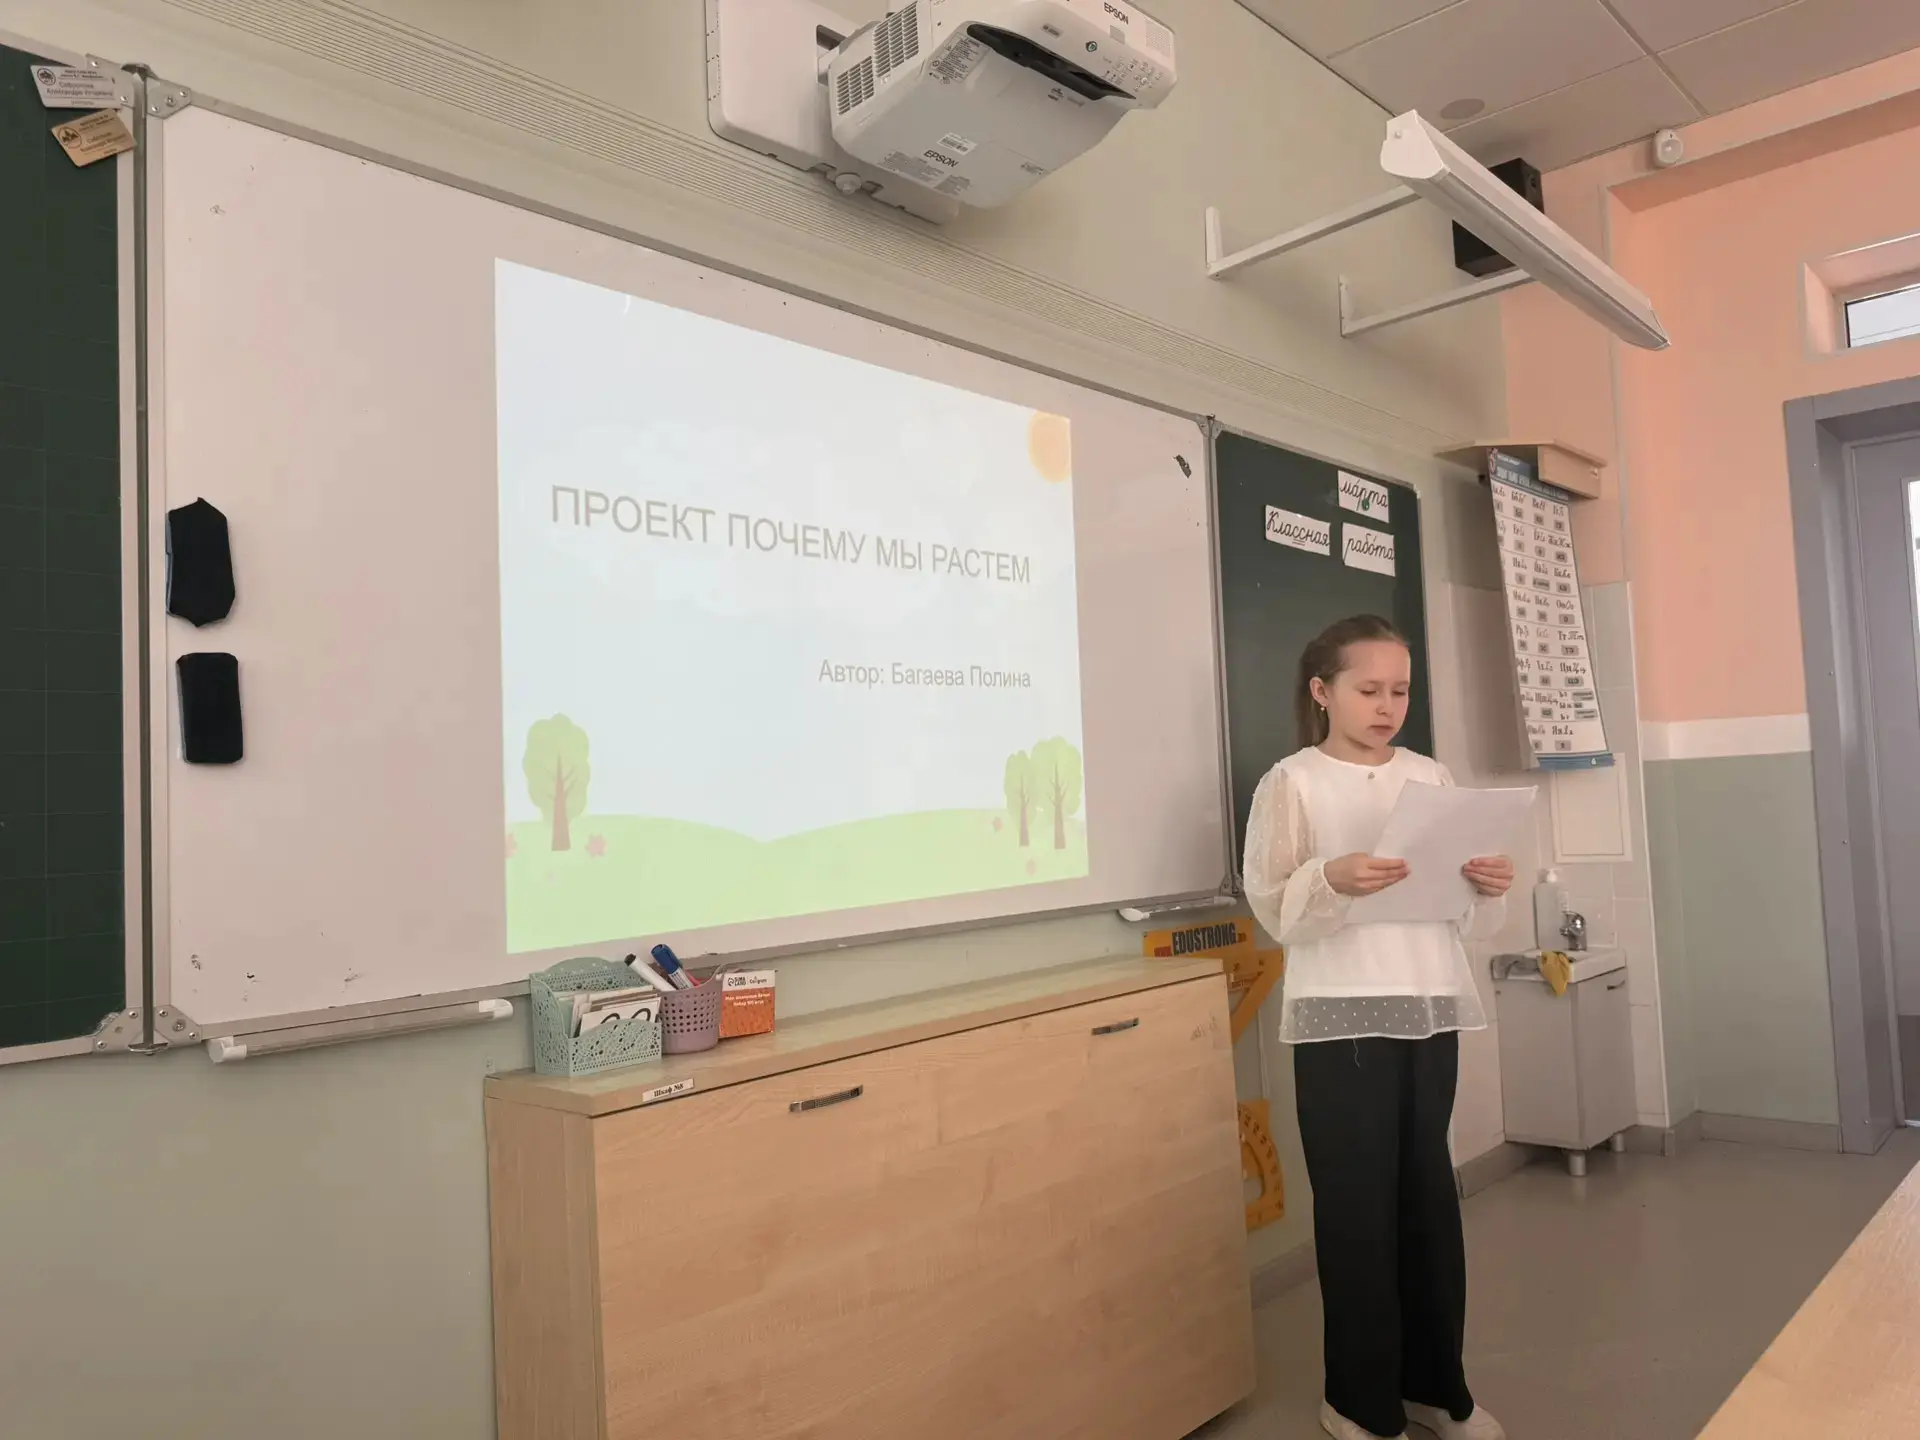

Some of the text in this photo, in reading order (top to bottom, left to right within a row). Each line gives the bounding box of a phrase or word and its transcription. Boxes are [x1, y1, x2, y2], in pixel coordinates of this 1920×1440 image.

[1103, 2, 1129, 25] EPSON
[923, 149, 960, 168] EPSON
[551, 484, 1031, 584] ПРОЕКТ ПОЧЕМУ МЫ РАСТЕМ
[1266, 510, 1330, 547] Классная
[1343, 533, 1395, 561] работа
[818, 659, 1032, 690] Автор: Багаева Полина
[1171, 921, 1238, 956] EDUSTRONG
[653, 1086, 673, 1098] Шкаф
